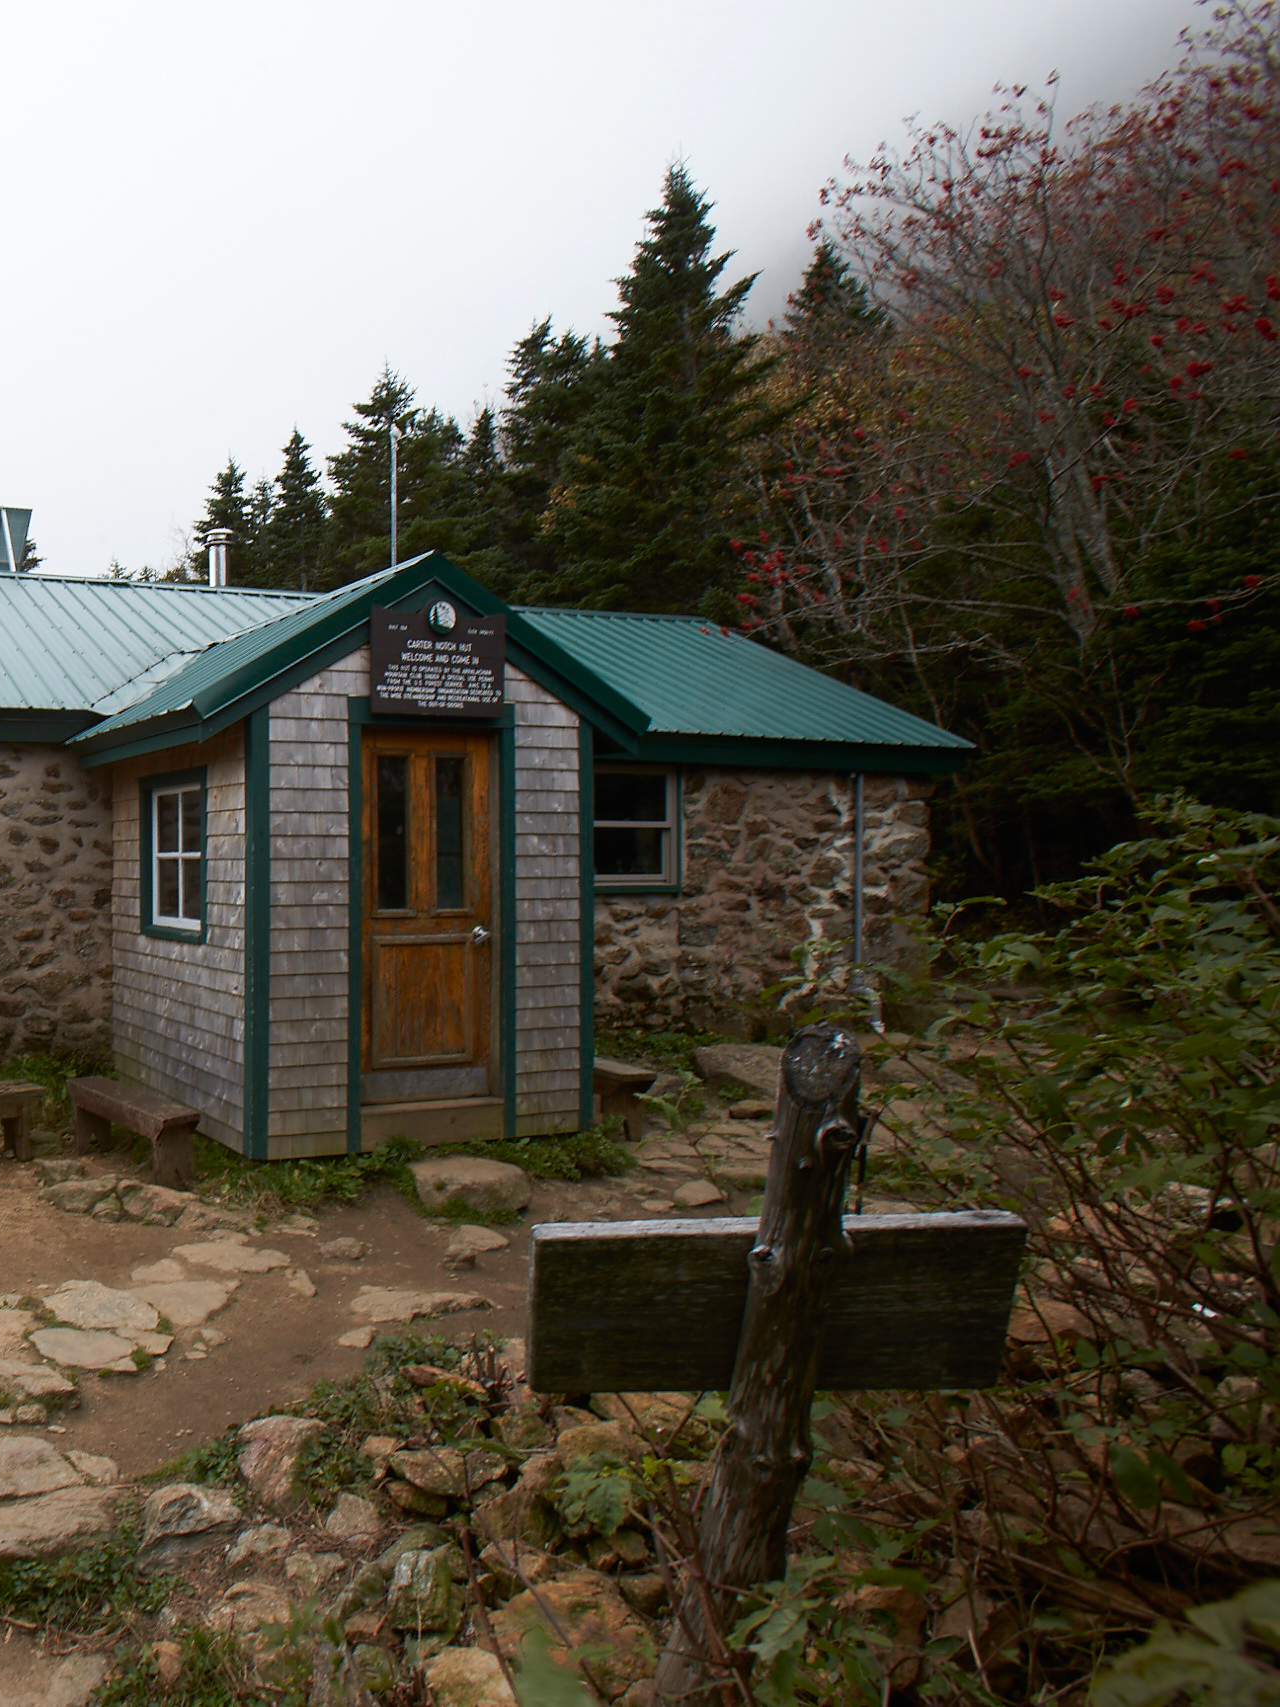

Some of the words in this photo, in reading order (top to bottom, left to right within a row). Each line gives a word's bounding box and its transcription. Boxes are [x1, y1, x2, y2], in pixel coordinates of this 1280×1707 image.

[407, 640, 433, 650] CARTER
[435, 641, 456, 651] NOTCH
[459, 643, 472, 652] HUT
[401, 652, 434, 663] WELCOME
[435, 654, 450, 664] AND
[451, 655, 471, 665] COME
[472, 656, 479, 665] IN
[419, 665, 442, 673] OPERATED
